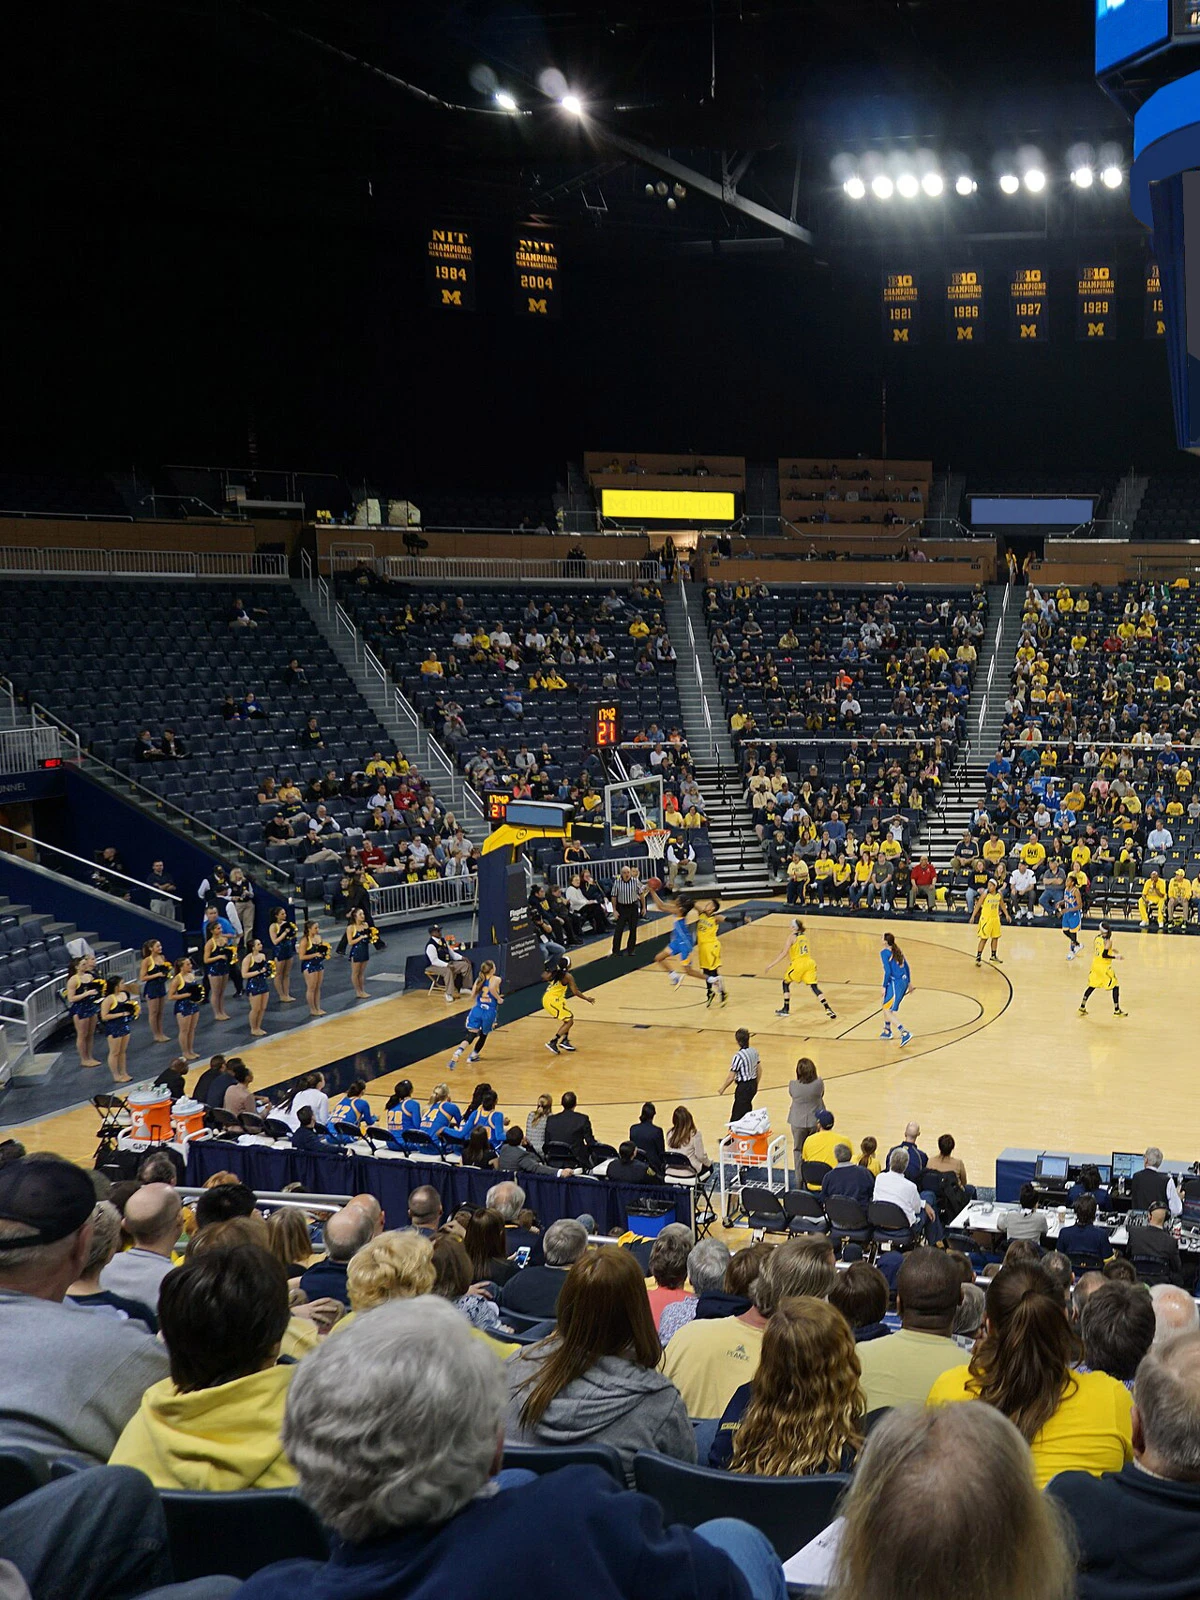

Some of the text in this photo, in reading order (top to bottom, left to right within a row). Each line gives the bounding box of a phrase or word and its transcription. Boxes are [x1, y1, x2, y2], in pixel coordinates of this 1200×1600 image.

[432, 230, 468, 244] NIT
[428, 242, 472, 254] CHAMPIONS
[519, 240, 554, 253] NIT
[516, 252, 558, 264] CHAMPIONS
[436, 266, 466, 282] 1984
[521, 275, 552, 290] 2004
[947, 284, 982, 294] CHAMPIONS
[1010, 282, 1046, 291] CHAMPIONS
[1078, 280, 1114, 289] CHAMPIONS
[442, 290, 462, 306] M
[884, 287, 918, 296] CHAMPIONS
[528, 298, 548, 314] M
[954, 306, 978, 318] 1926
[1016, 303, 1041, 316] 1927
[1084, 301, 1108, 314] 1929
[890, 308, 912, 320] 1921
[893, 328, 909, 342] M
[957, 326, 973, 340] M
[1020, 324, 1037, 338] M
[1088, 322, 1104, 336] M
[598, 708, 616, 721] 17:42
[596, 722, 616, 745] 21
[490, 794, 510, 804] 17:42
[491, 804, 506, 818] 21
[800, 945, 808, 954] 14
[482, 987, 490, 998] 2
[333, 1105, 350, 1118] 22
[132, 1111, 144, 1126] G
[177, 1122, 186, 1132] G
[739, 1141, 748, 1150] G
